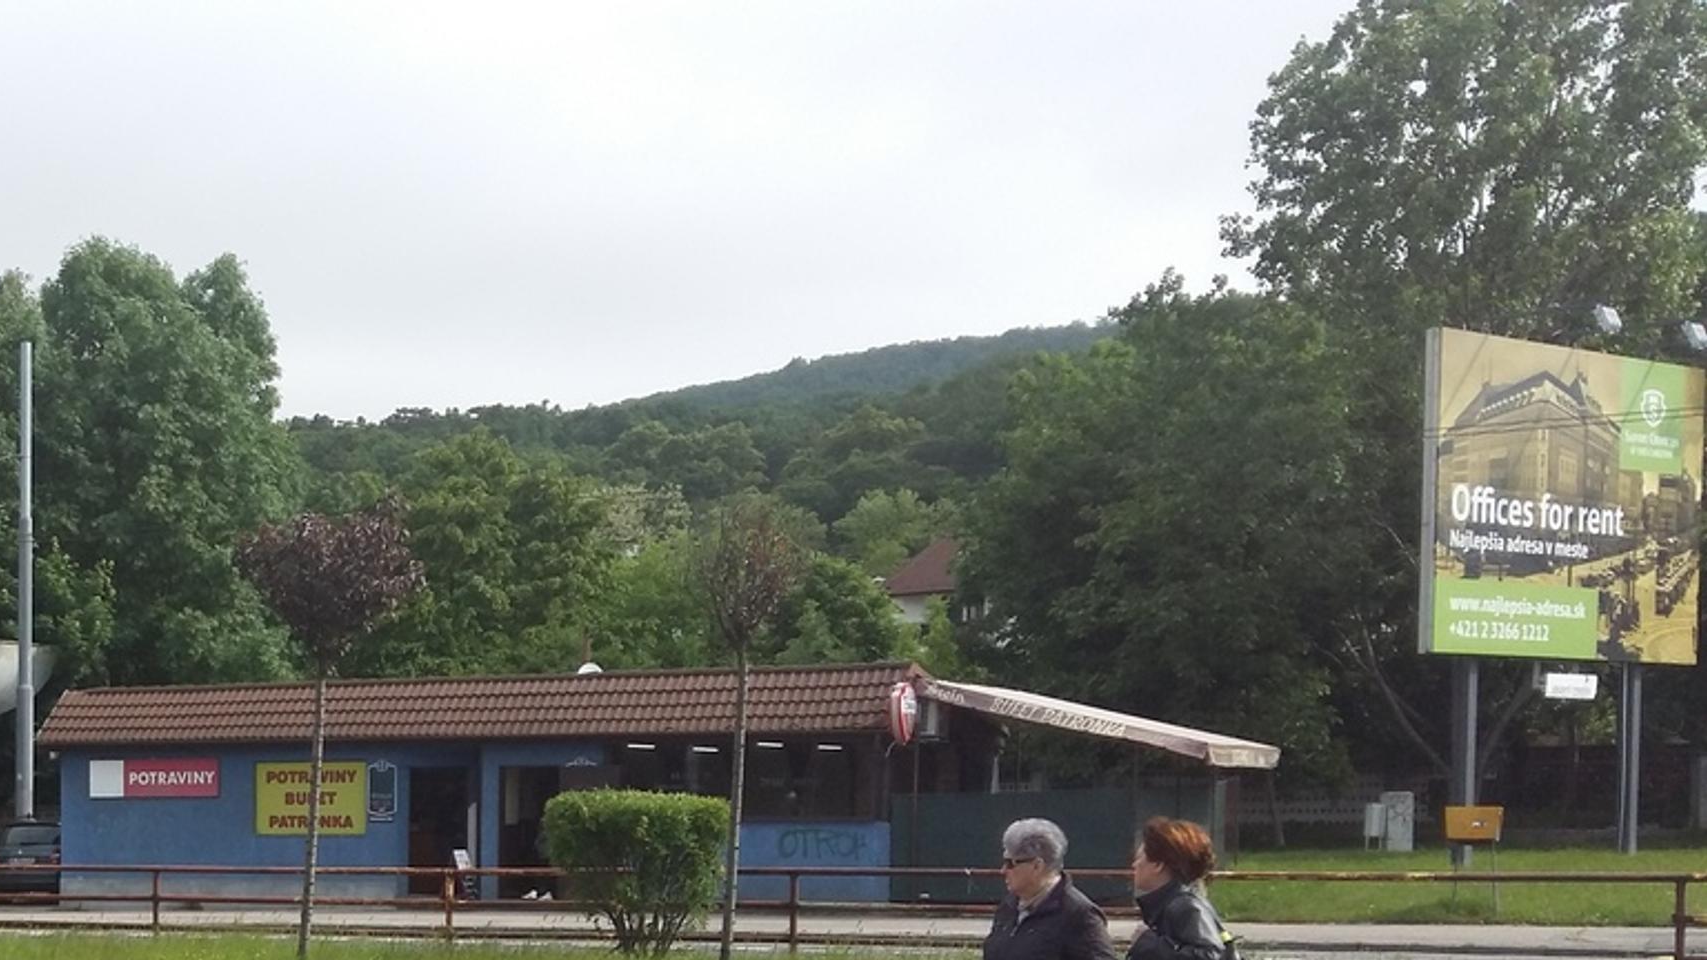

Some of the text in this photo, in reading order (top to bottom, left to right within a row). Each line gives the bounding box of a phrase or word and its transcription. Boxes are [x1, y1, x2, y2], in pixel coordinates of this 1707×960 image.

[1451, 484, 1624, 536] Offices for rent
[1506, 534, 1544, 555] adresa
[1449, 619, 1478, 638] +421
[1522, 624, 1549, 641] 1212
[129, 771, 215, 786] POTRAVINY
[266, 770, 357, 784] POTRVINY
[284, 791, 337, 805] BUET
[269, 815, 354, 829] PATRNKA
